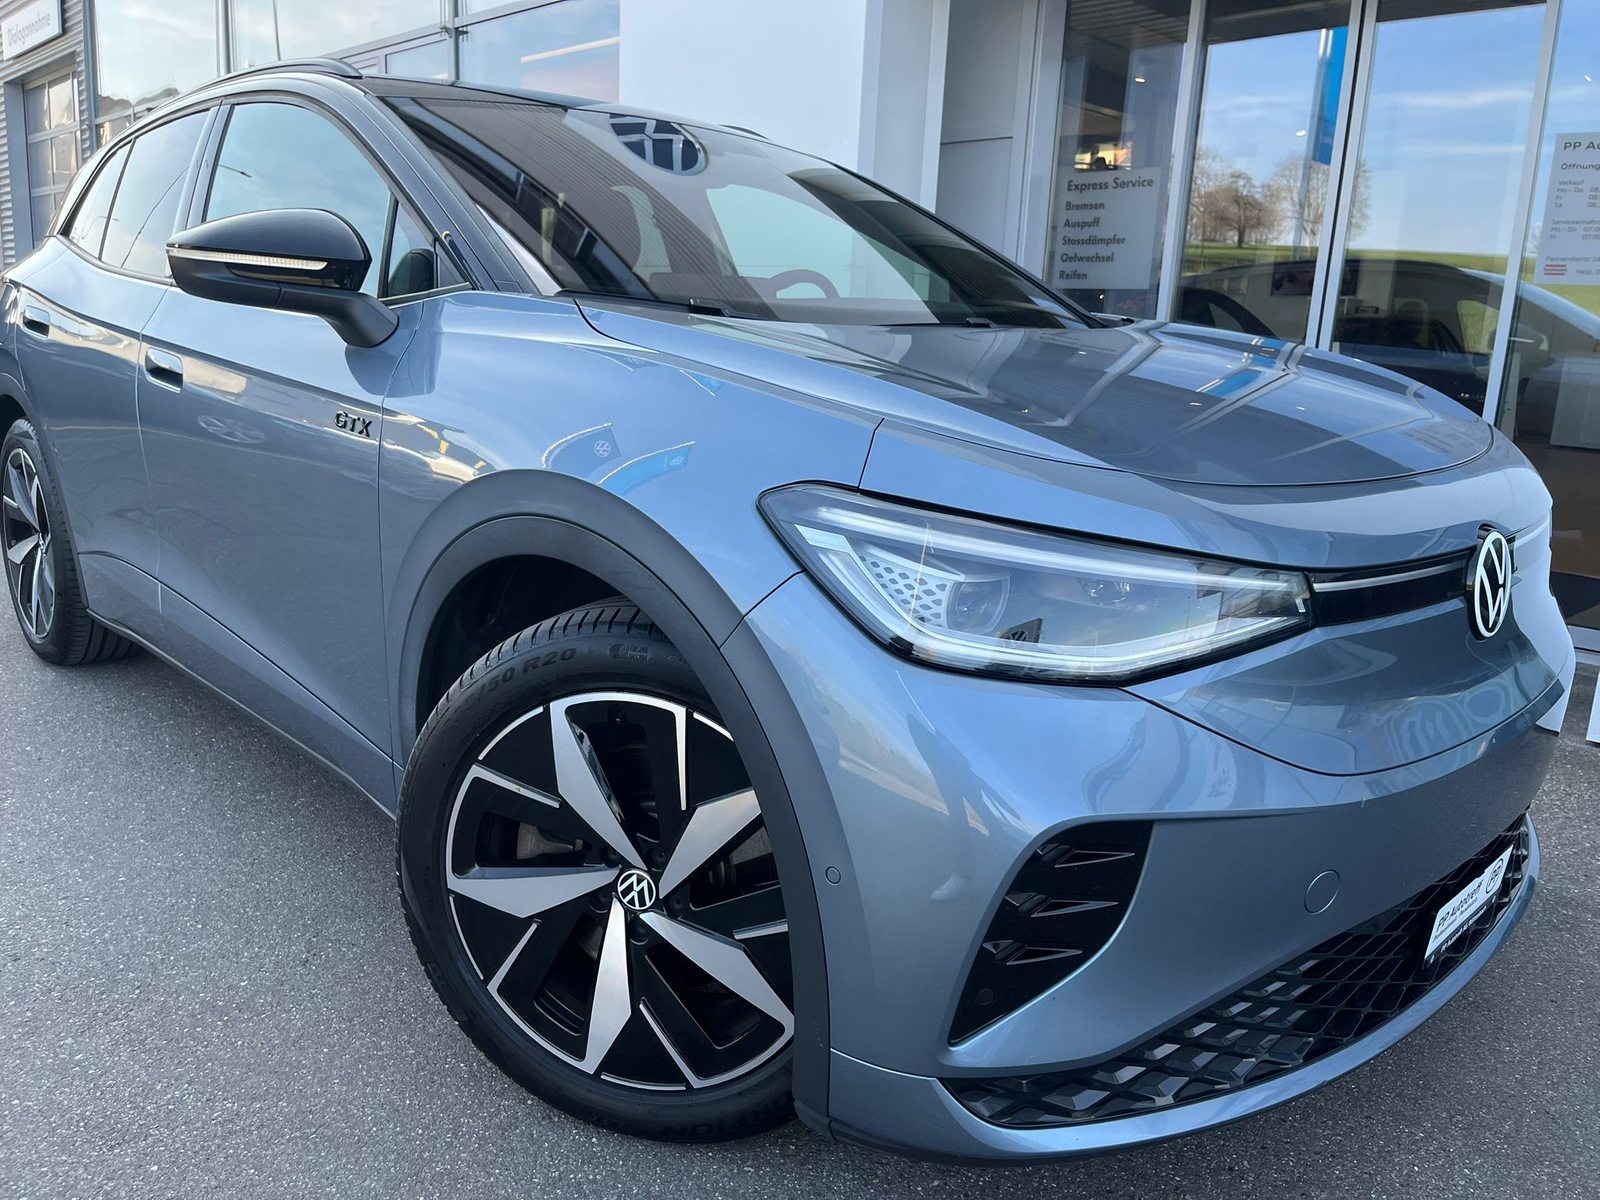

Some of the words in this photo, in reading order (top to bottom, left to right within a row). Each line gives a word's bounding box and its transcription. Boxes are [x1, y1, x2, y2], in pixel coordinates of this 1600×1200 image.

[1563, 141, 1582, 150] PP
[1066, 180, 1109, 193] Express
[1112, 176, 1154, 189] Service
[1065, 201, 1105, 211] Bremsen
[1063, 217, 1101, 230] Auspuff
[1061, 234, 1126, 247] Stossdämpfer
[1060, 252, 1114, 263] Oelwechsel
[1058, 270, 1087, 280] Reifen
[334, 411, 372, 437] GTX
